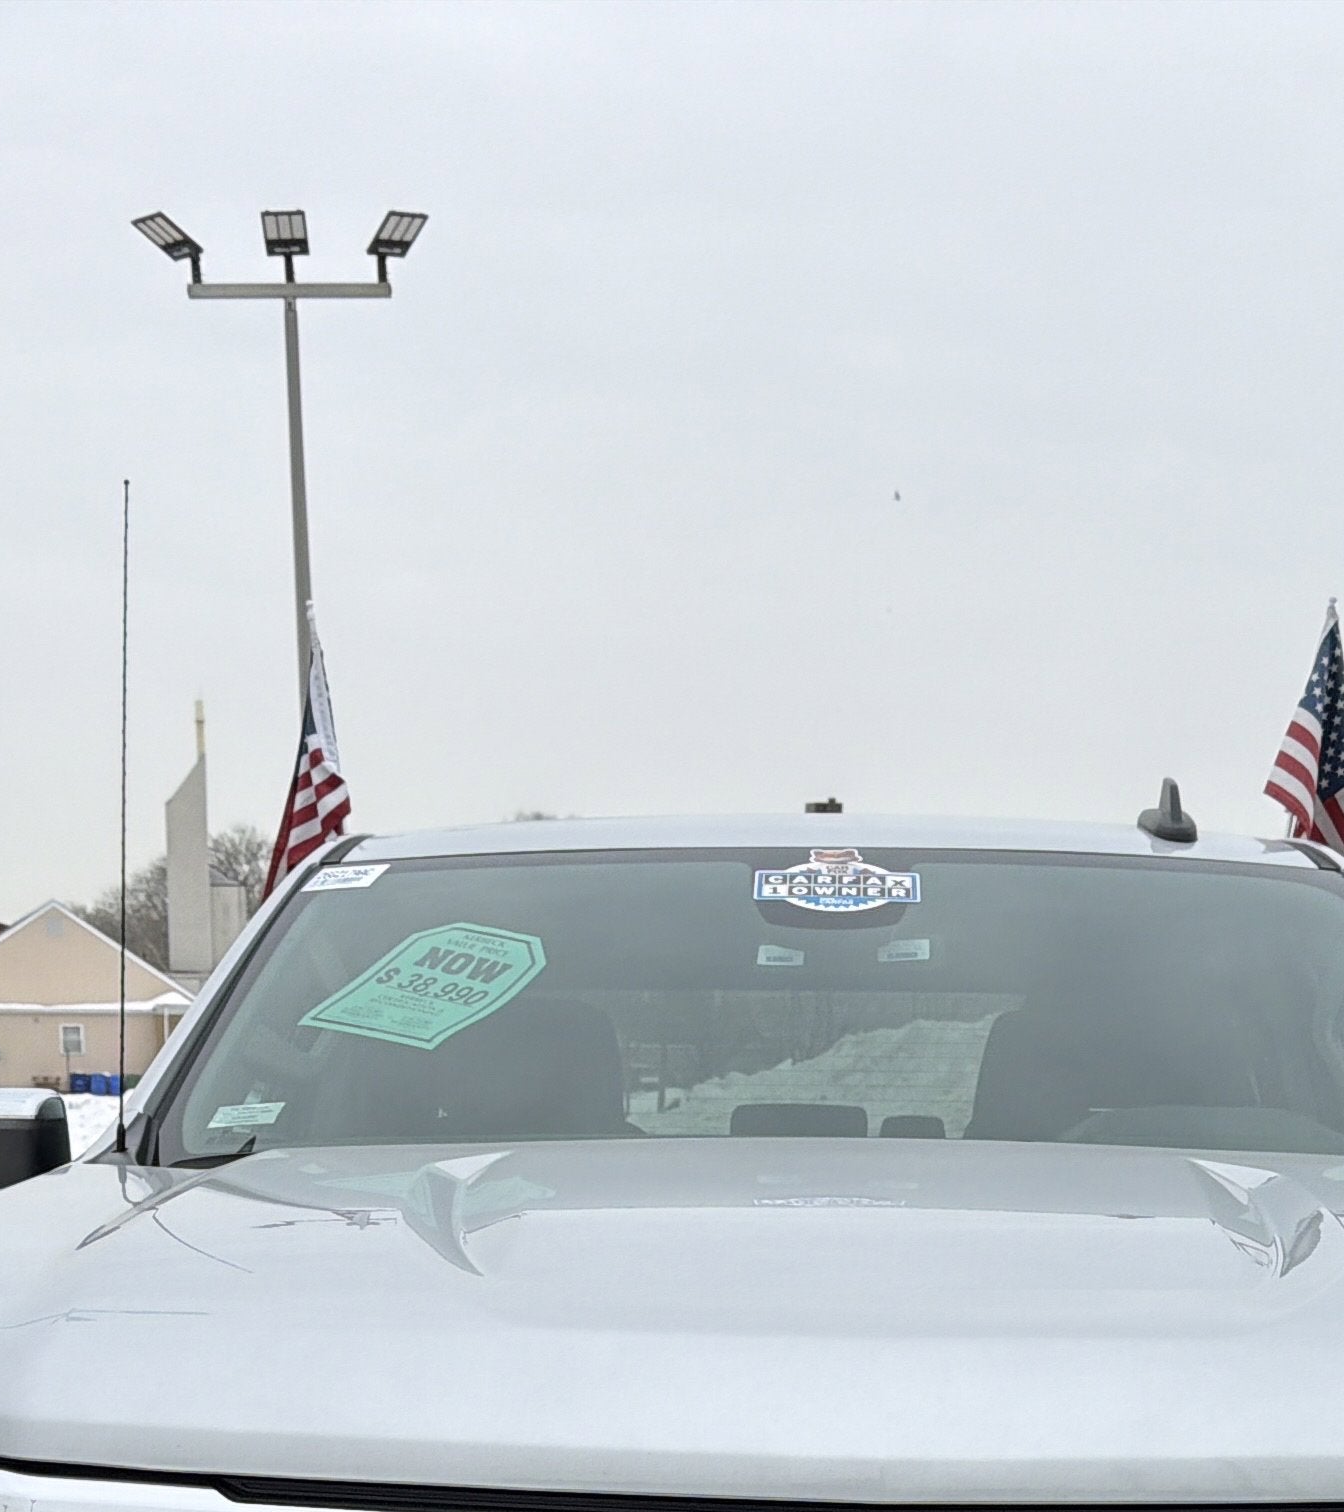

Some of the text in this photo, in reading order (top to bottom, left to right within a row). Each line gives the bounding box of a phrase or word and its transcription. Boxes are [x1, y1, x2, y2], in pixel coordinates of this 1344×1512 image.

[768, 875, 907, 888] CARFAX
[768, 886, 906, 897] 1 OWNER
[413, 946, 514, 984] NOW
[375, 967, 401, 985] $
[397, 973, 489, 1006] 38,990
